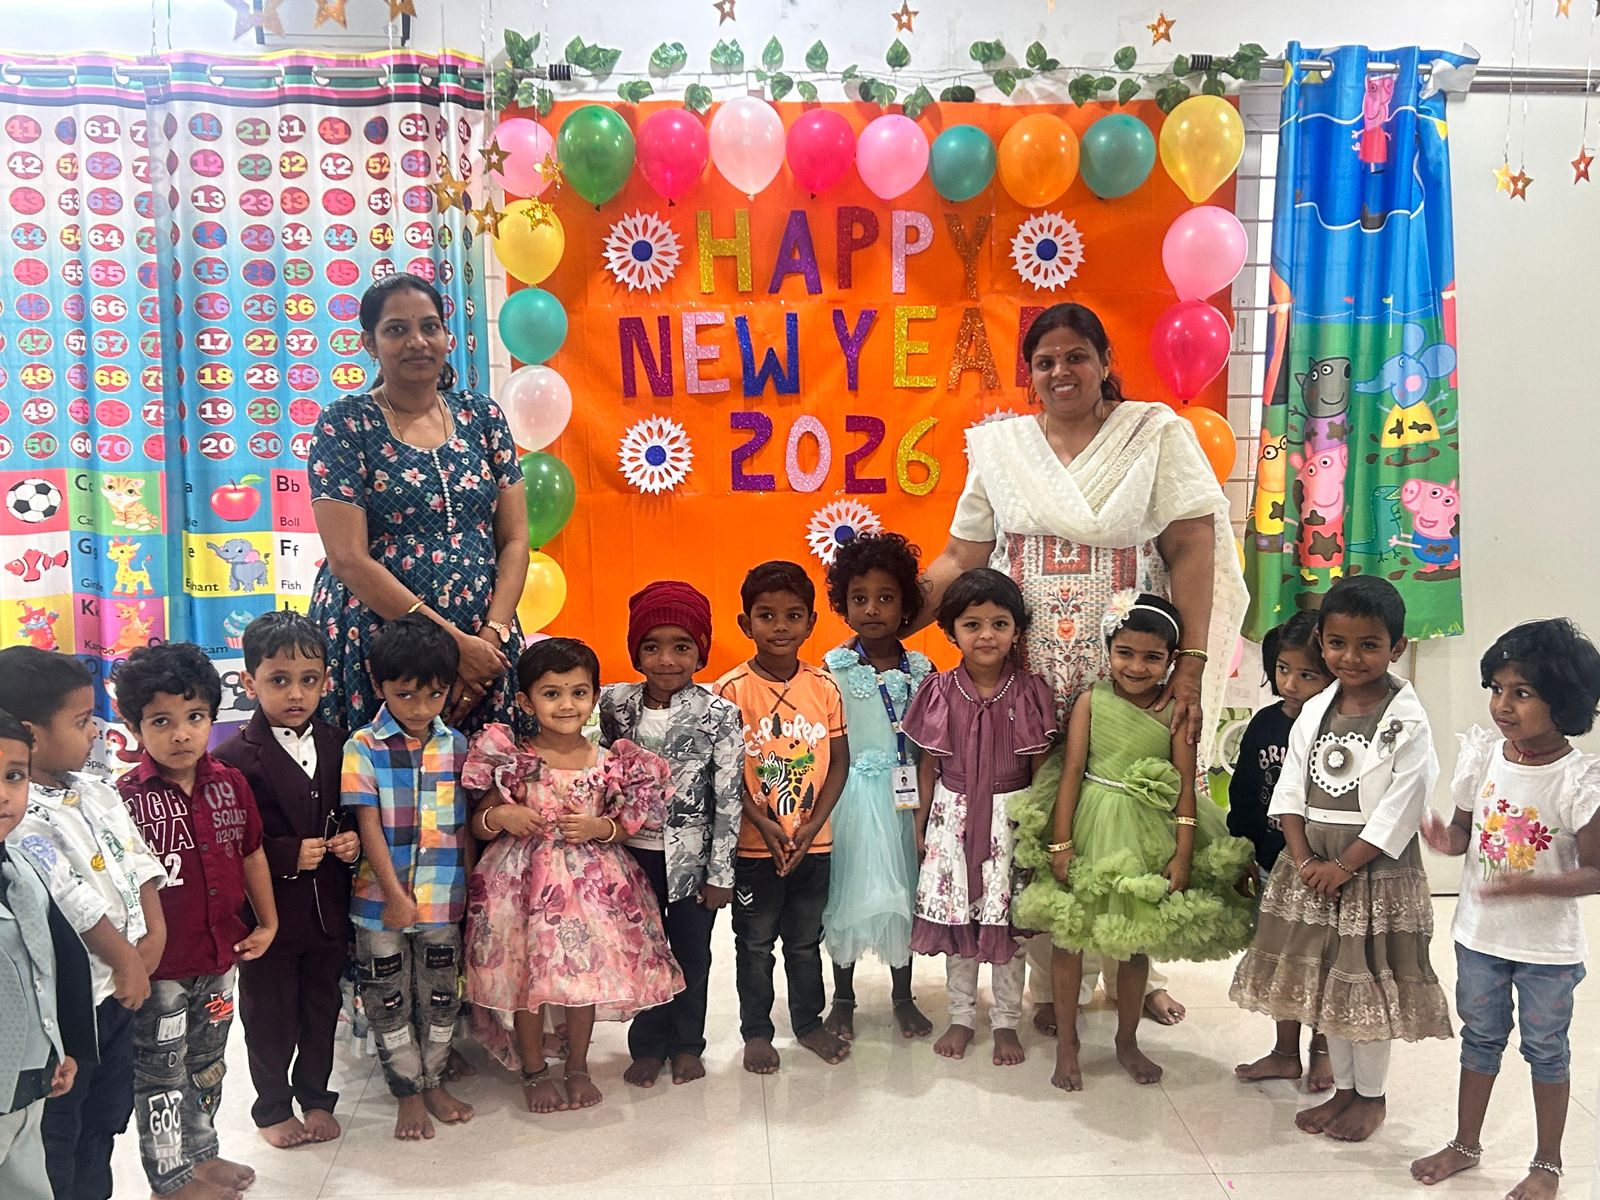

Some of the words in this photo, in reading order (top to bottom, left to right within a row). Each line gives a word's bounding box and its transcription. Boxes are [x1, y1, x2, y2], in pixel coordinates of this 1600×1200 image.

[7, 120, 39, 138] 41
[85, 120, 120, 138] 61
[131, 125, 146, 141] 7
[191, 118, 220, 137] 11
[238, 124, 270, 139] 21
[279, 120, 304, 137] 31
[320, 123, 348, 139] 41
[400, 118, 429, 136] 61
[8, 156, 41, 174] 42
[86, 156, 120, 174] 62
[192, 154, 223, 171] 12
[239, 160, 272, 175] 22
[280, 157, 306, 172] 32
[322, 158, 351, 175] 42
[368, 157, 390, 173] 52
[87, 191, 121, 209] 63
[192, 191, 225, 208] 13
[241, 194, 272, 210] 23
[281, 192, 308, 208] 33
[369, 193, 391, 210] 53
[12, 227, 46, 245] 44
[89, 229, 122, 247] 64
[194, 226, 227, 244] 14
[242, 230, 274, 245] 24
[282, 227, 311, 245] 34
[325, 230, 357, 246] 44
[372, 229, 394, 244] 54
[406, 228, 434, 245] 64
[697, 206, 992, 298] HAPPY
[90, 265, 123, 281] 65
[196, 263, 228, 280] 15
[244, 264, 274, 280] 25
[284, 264, 311, 279] 35
[16, 298, 48, 315] 46
[91, 300, 127, 316] 66
[199, 297, 229, 314] 16
[245, 299, 277, 315] 26
[285, 299, 314, 315] 36
[328, 298, 360, 316] 46
[19, 334, 49, 351] 47
[93, 335, 124, 352] 67
[199, 334, 230, 350] 17
[247, 335, 278, 351] 27
[286, 335, 315, 351] 37
[332, 334, 360, 351] 47
[619, 311, 800, 398] NEW
[20, 367, 52, 385] 48
[94, 369, 128, 386] 68
[200, 368, 233, 384] 18
[247, 368, 280, 384] 28
[288, 368, 319, 384] 38
[332, 367, 364, 384] 48
[23, 403, 54, 419] 49
[201, 402, 234, 419] 19
[249, 402, 280, 419] 29
[25, 438, 56, 454] 50
[98, 440, 130, 456] 70
[201, 437, 236, 453] 20
[251, 437, 282, 453] 30
[730, 411, 942, 497] 2026
[276, 475, 300, 493] Bb
[280, 539, 299, 556] Ff
[281, 580, 301, 590] Fish
[204, 781, 236, 810] 09
